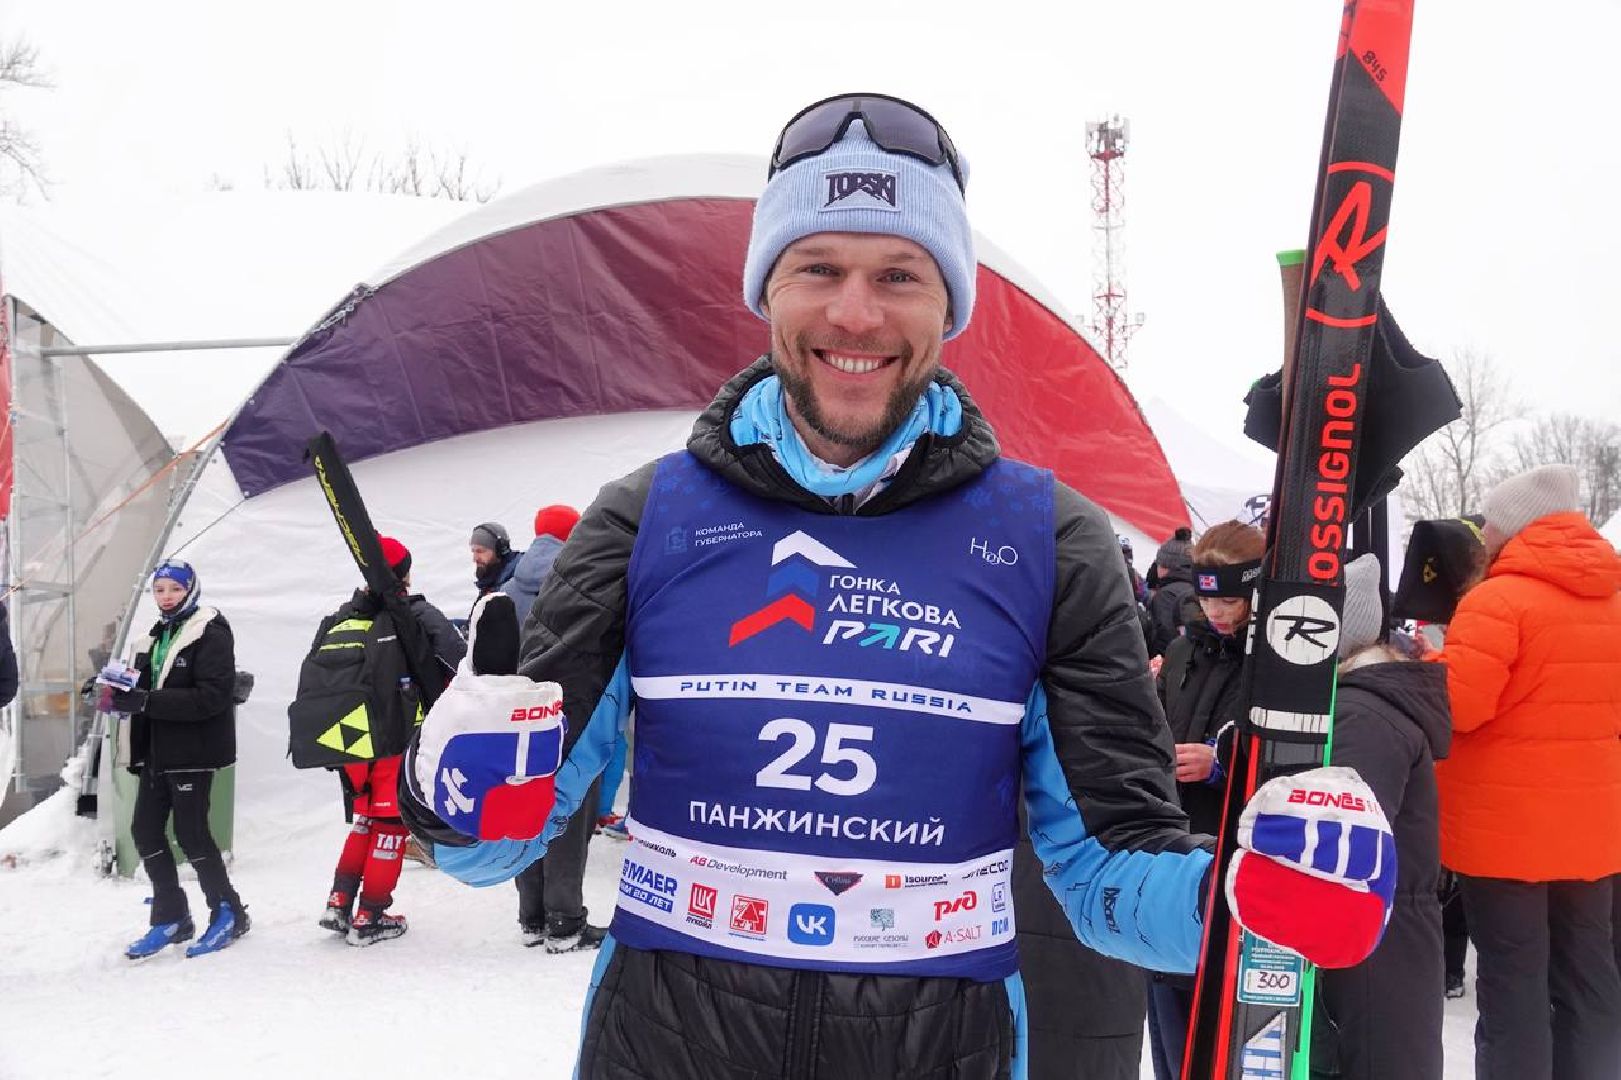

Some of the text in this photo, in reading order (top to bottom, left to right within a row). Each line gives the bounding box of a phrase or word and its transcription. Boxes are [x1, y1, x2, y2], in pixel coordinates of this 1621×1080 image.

[1307, 363, 1361, 586] OSSIGNOL
[829, 575, 901, 596] ГОНКА
[827, 592, 962, 630] ЛЕГКОВА
[822, 619, 955, 658] PARI
[680, 680, 972, 713] PUTIN TEAM RUSSIA
[755, 718, 878, 796] 25
[689, 800, 946, 846] ПАНЖИНСКИЙ
[627, 862, 678, 897] MAER
[706, 859, 788, 880] Development
[1257, 971, 1290, 989] 300
